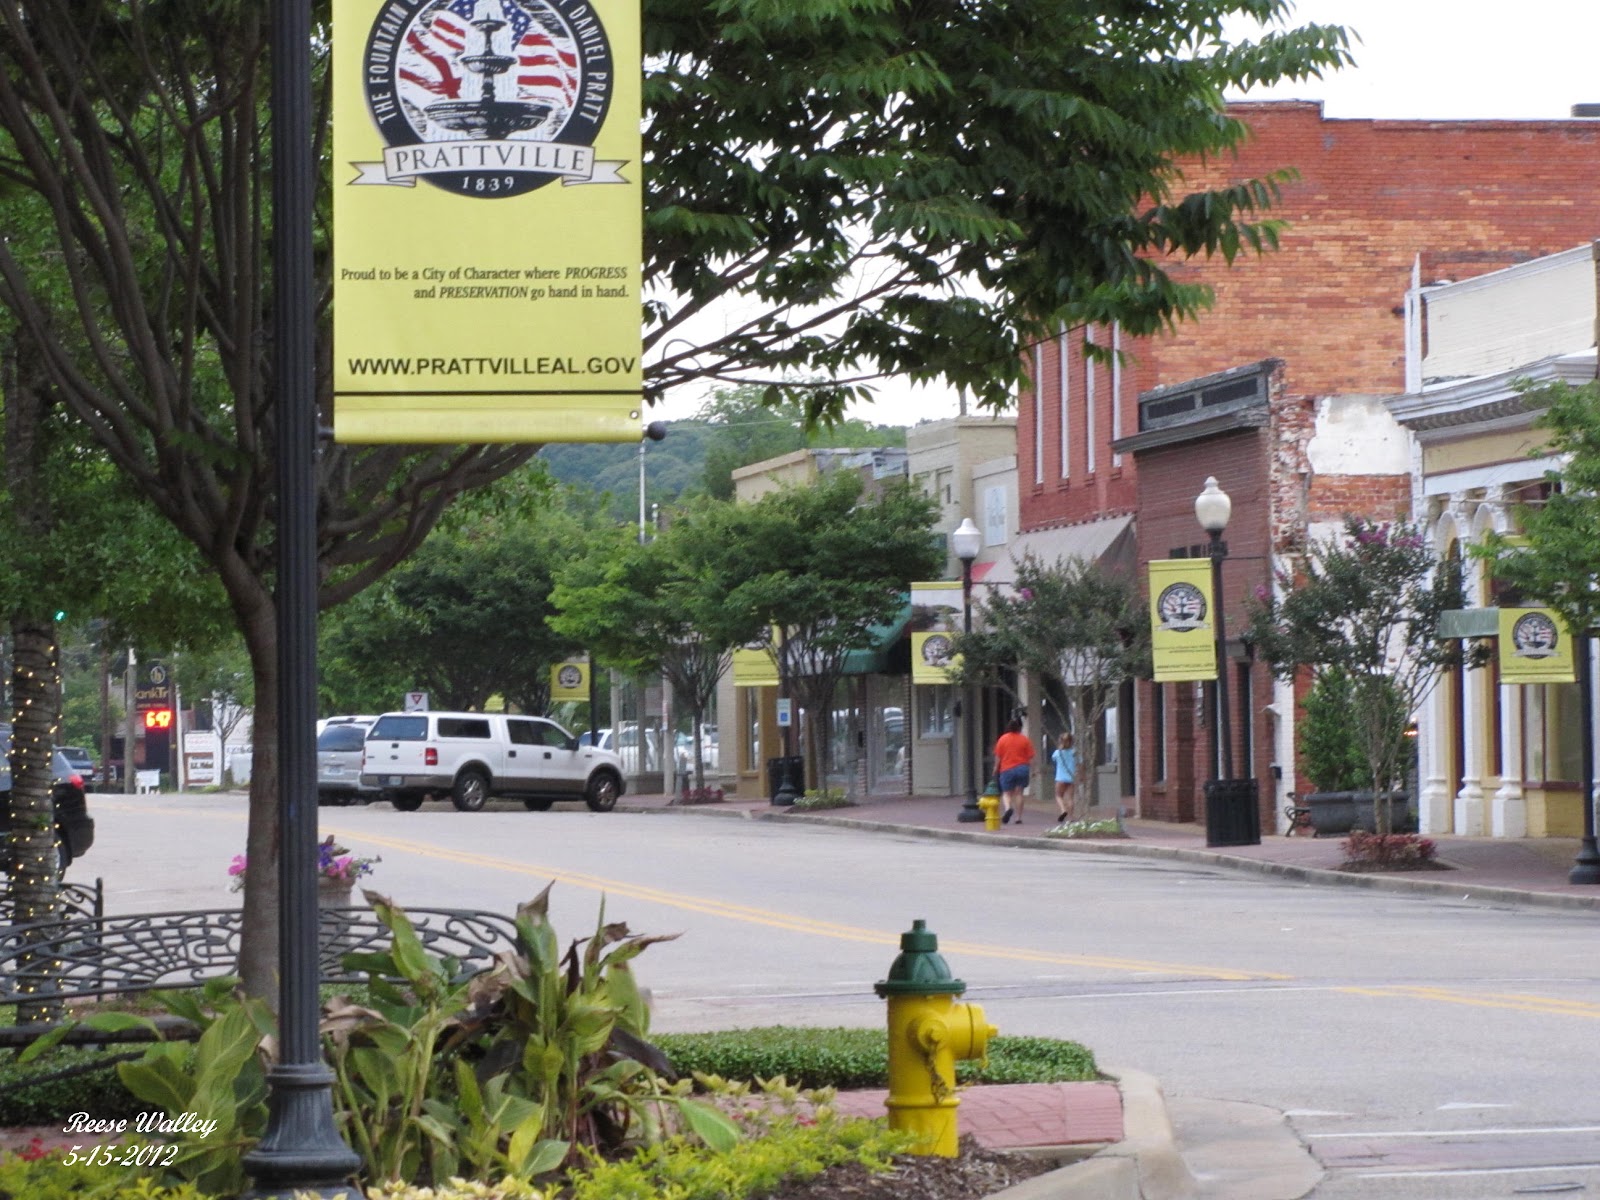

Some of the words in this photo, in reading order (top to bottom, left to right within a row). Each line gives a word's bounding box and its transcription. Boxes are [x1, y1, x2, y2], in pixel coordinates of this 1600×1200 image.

[369, 2, 409, 84] FOUNTAIN
[569, 4, 606, 64] DANIEL
[372, 91, 397, 125] THE
[580, 72, 607, 124] PRATT
[395, 144, 585, 172] PRATTVILLE
[462, 176, 515, 191] 1839
[341, 268, 376, 280] Proud
[379, 268, 391, 280] to
[394, 267, 408, 280] be
[412, 271, 419, 280] a
[422, 267, 446, 282] City
[449, 267, 461, 280] of
[464, 266, 520, 280] Character
[524, 266, 560, 279] where
[565, 266, 628, 279] PROGRESS
[414, 286, 436, 298] and
[439, 286, 528, 298] PRESERVATION
[530, 287, 545, 300] go
[549, 285, 577, 298] hand
[581, 286, 593, 298] in
[596, 285, 629, 298] hand.
[348, 357, 636, 375] WWW.PRATTVILLEAL.GOV
